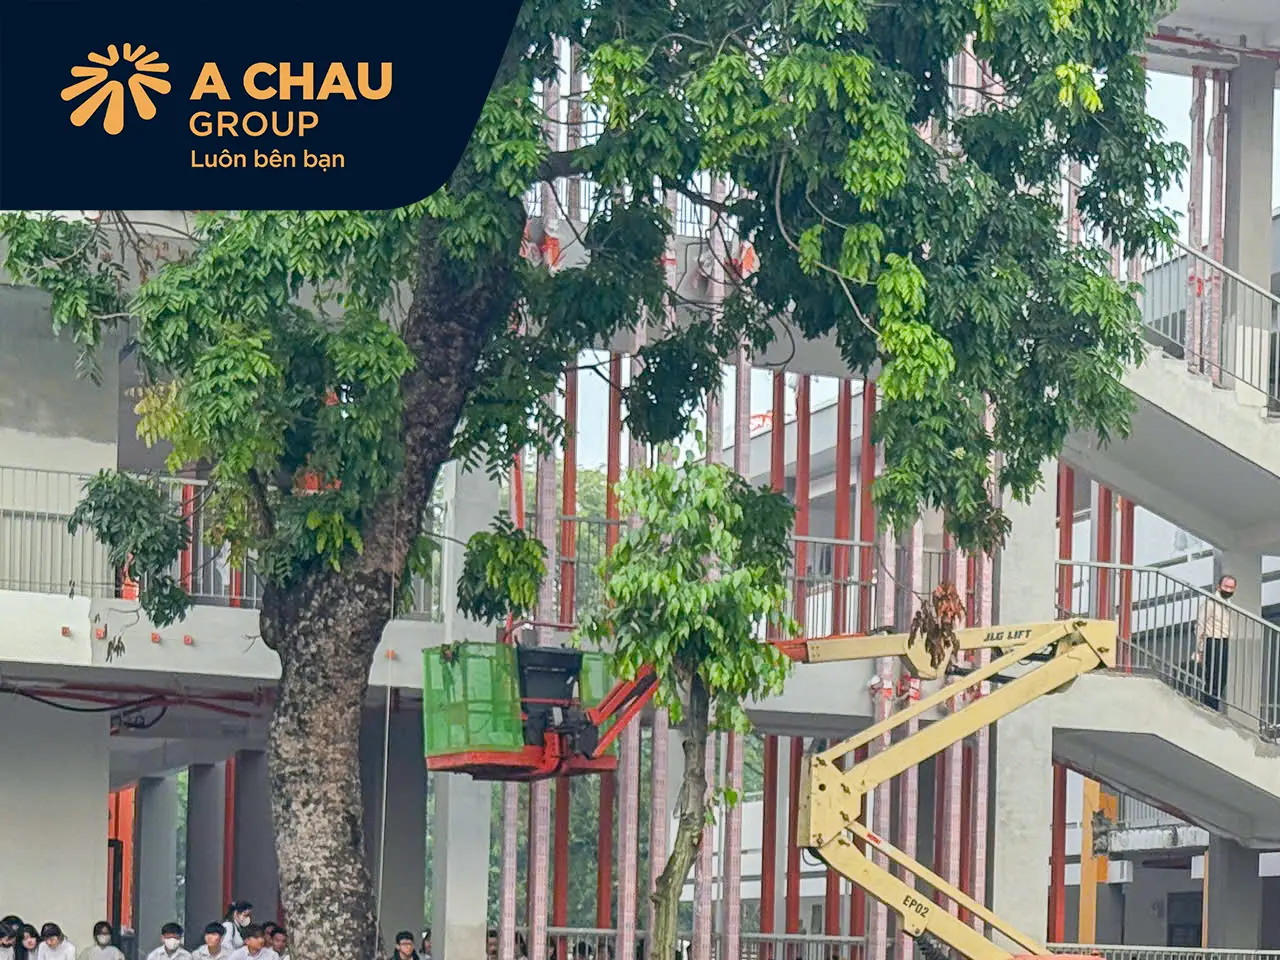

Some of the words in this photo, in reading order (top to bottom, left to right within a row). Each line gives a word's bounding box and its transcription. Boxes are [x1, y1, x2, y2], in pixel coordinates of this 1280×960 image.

[983, 631, 1005, 642] JLG
[1007, 629, 1033, 640] LIFT
[902, 894, 930, 918] EP02
